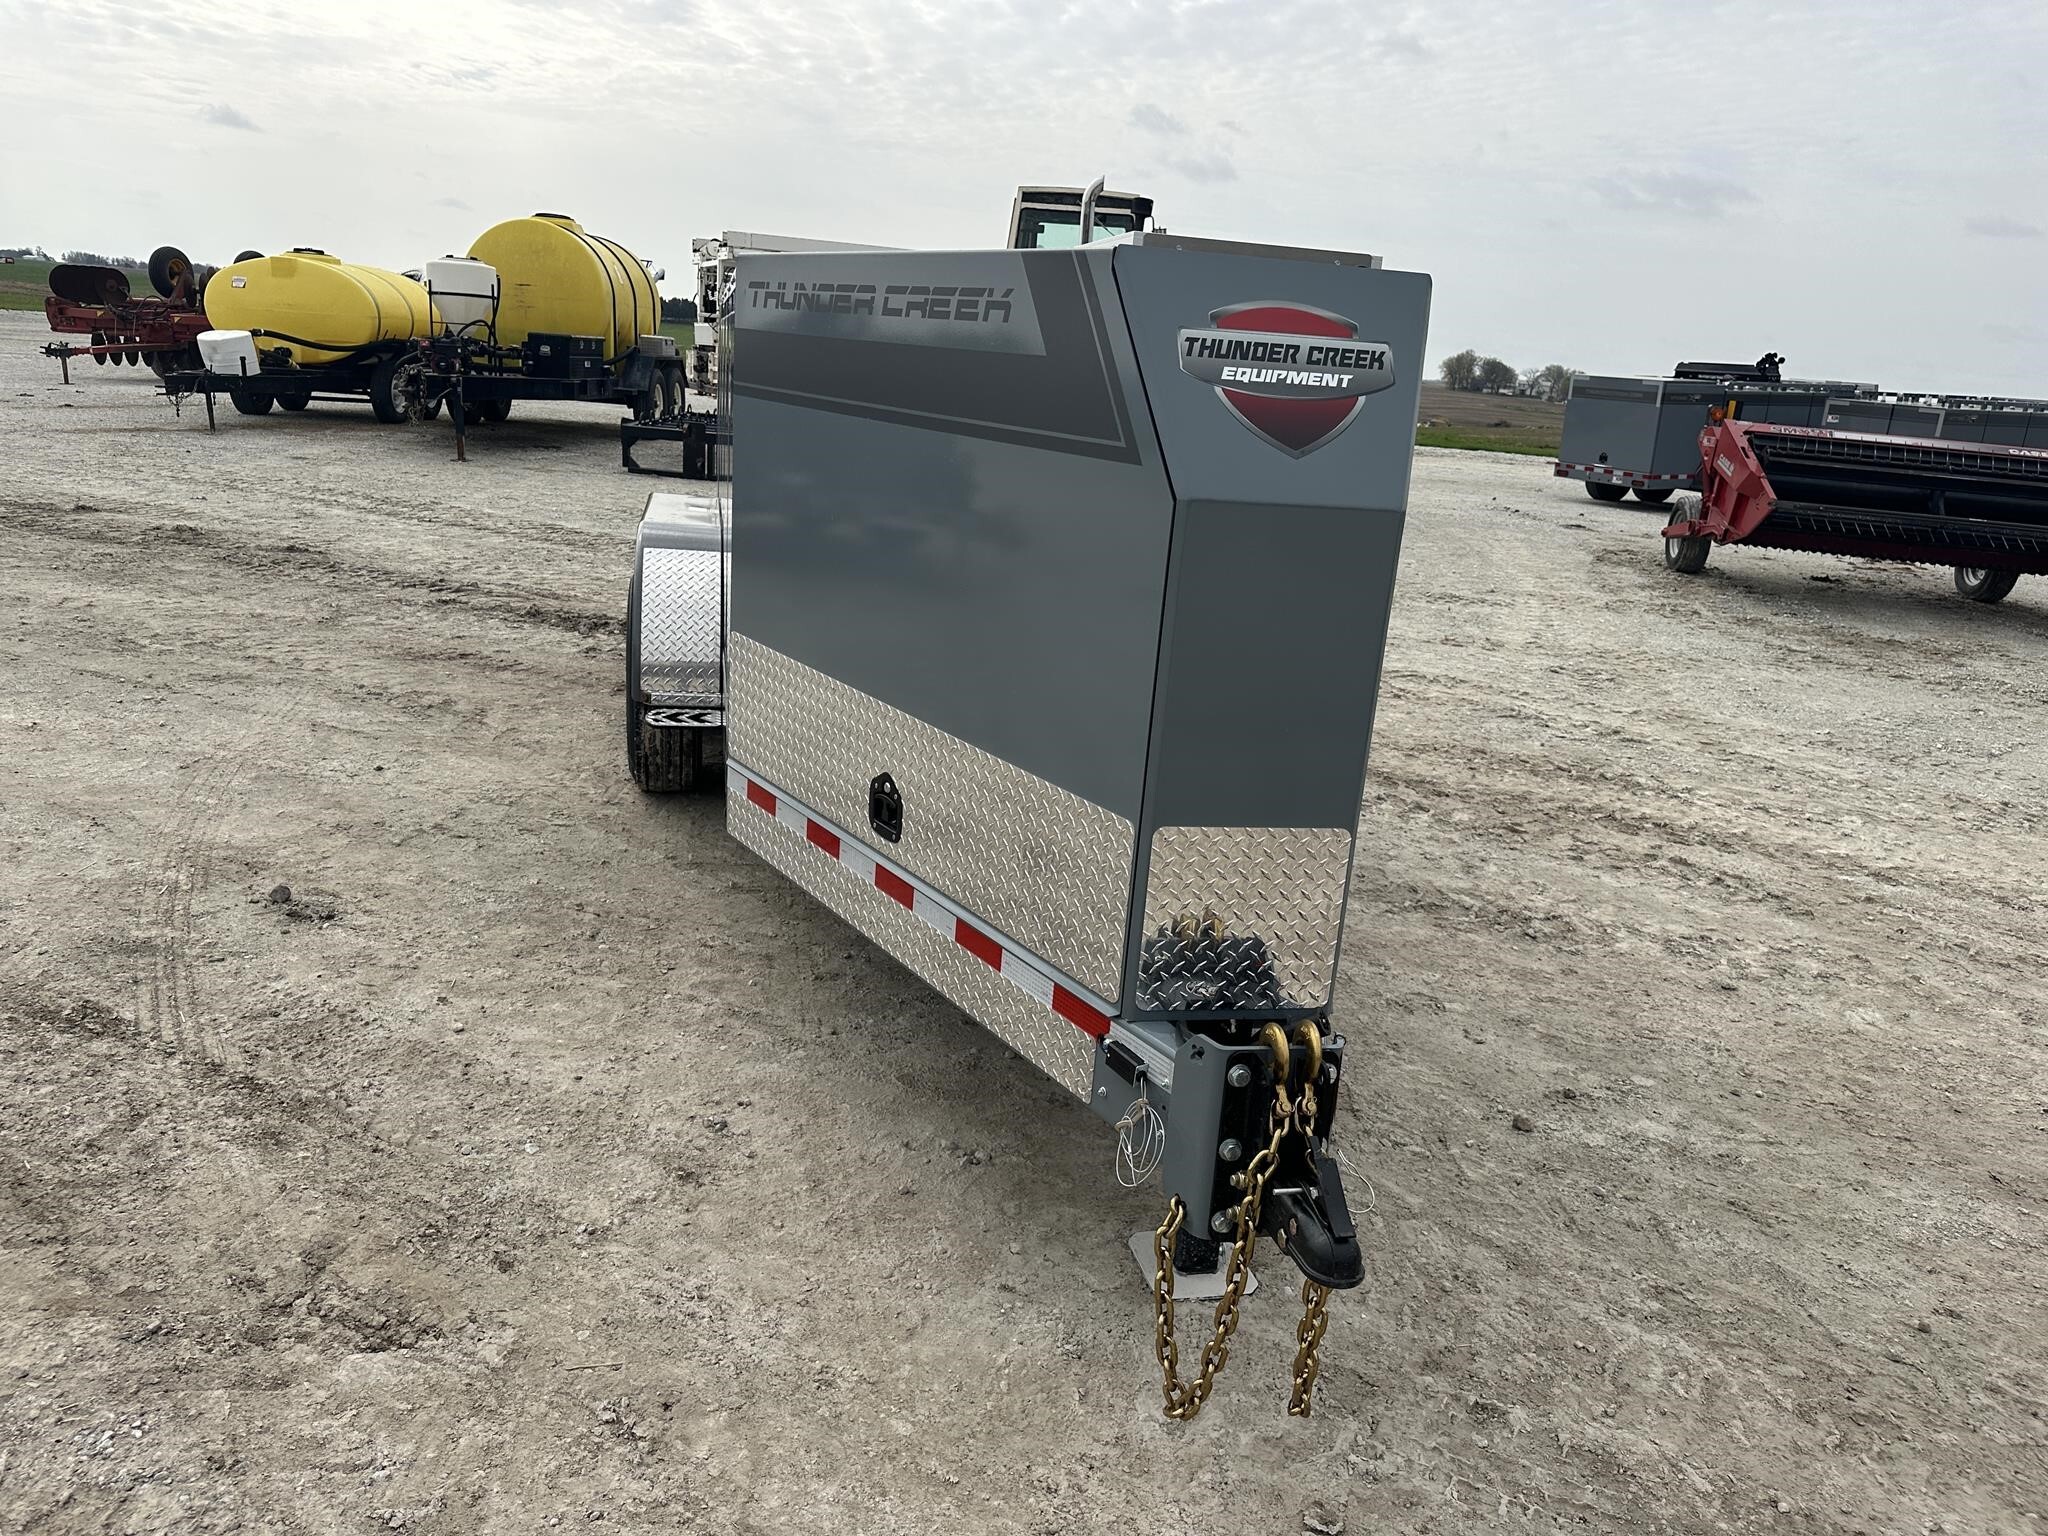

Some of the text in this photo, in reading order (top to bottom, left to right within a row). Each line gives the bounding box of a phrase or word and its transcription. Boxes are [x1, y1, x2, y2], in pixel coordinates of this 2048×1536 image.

[748, 281, 1015, 323] THUNDER CREEK
[1184, 336, 1386, 370] THUNDER CREEK
[1221, 366, 1354, 388] EQUIPMENT
